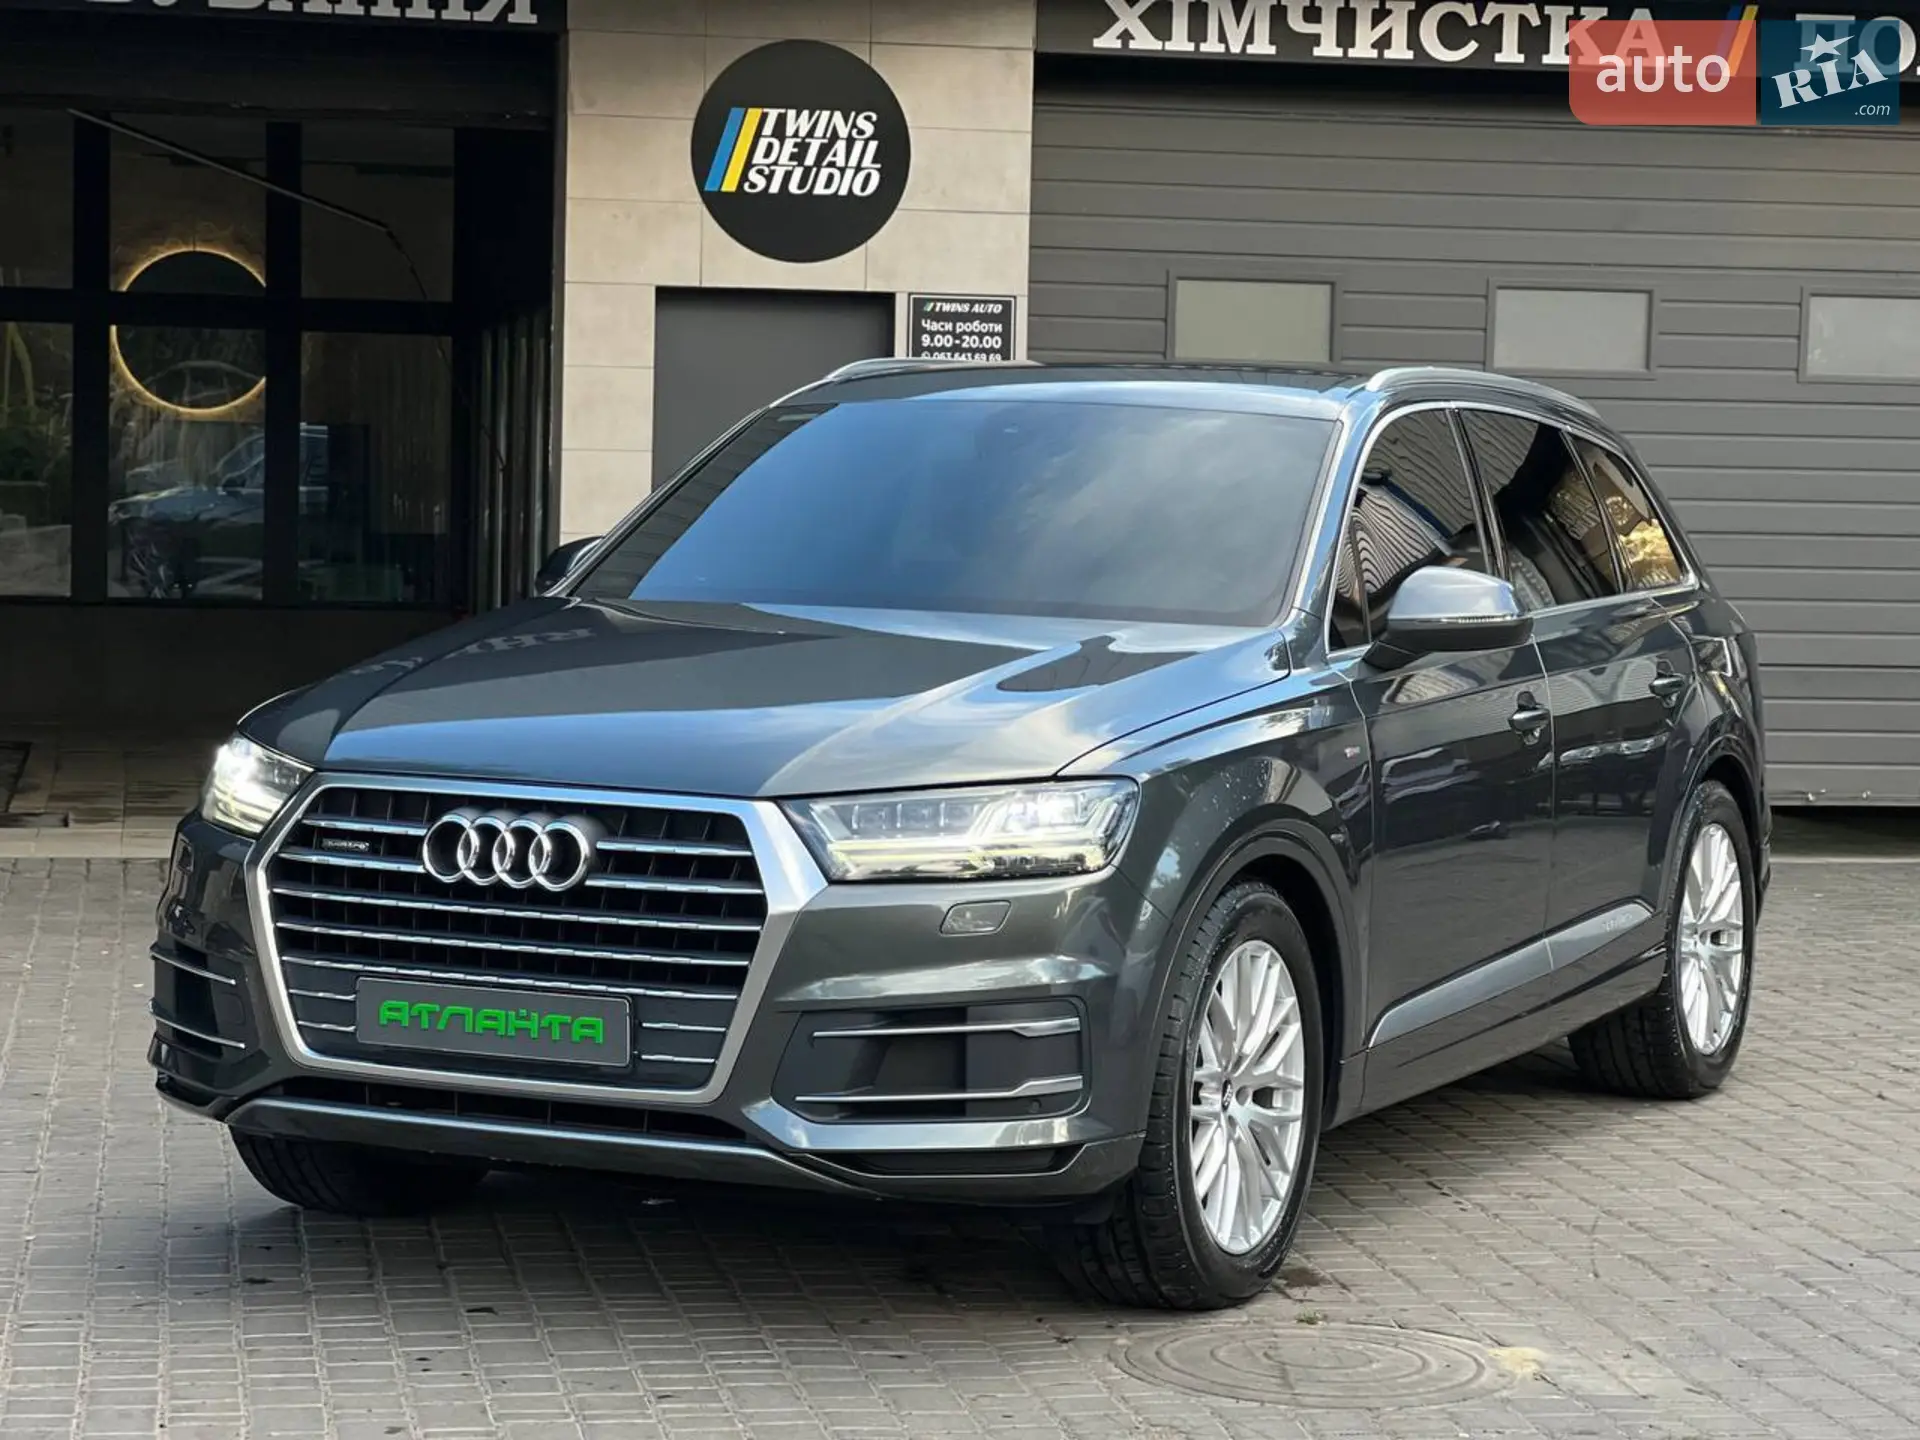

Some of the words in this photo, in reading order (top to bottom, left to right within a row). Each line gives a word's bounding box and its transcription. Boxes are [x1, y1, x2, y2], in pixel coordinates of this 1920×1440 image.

[1093, 0, 1670, 67] ХІМЧИСТКА
[1794, 13, 1920, 76] ПО
[761, 108, 878, 139] TWINS
[751, 137, 882, 169] DETAIL
[743, 165, 881, 197] STUDIO
[935, 302, 970, 313] TWINS
[971, 303, 1003, 314] AUTO
[921, 319, 953, 332] Часи
[955, 320, 1003, 334] роботи
